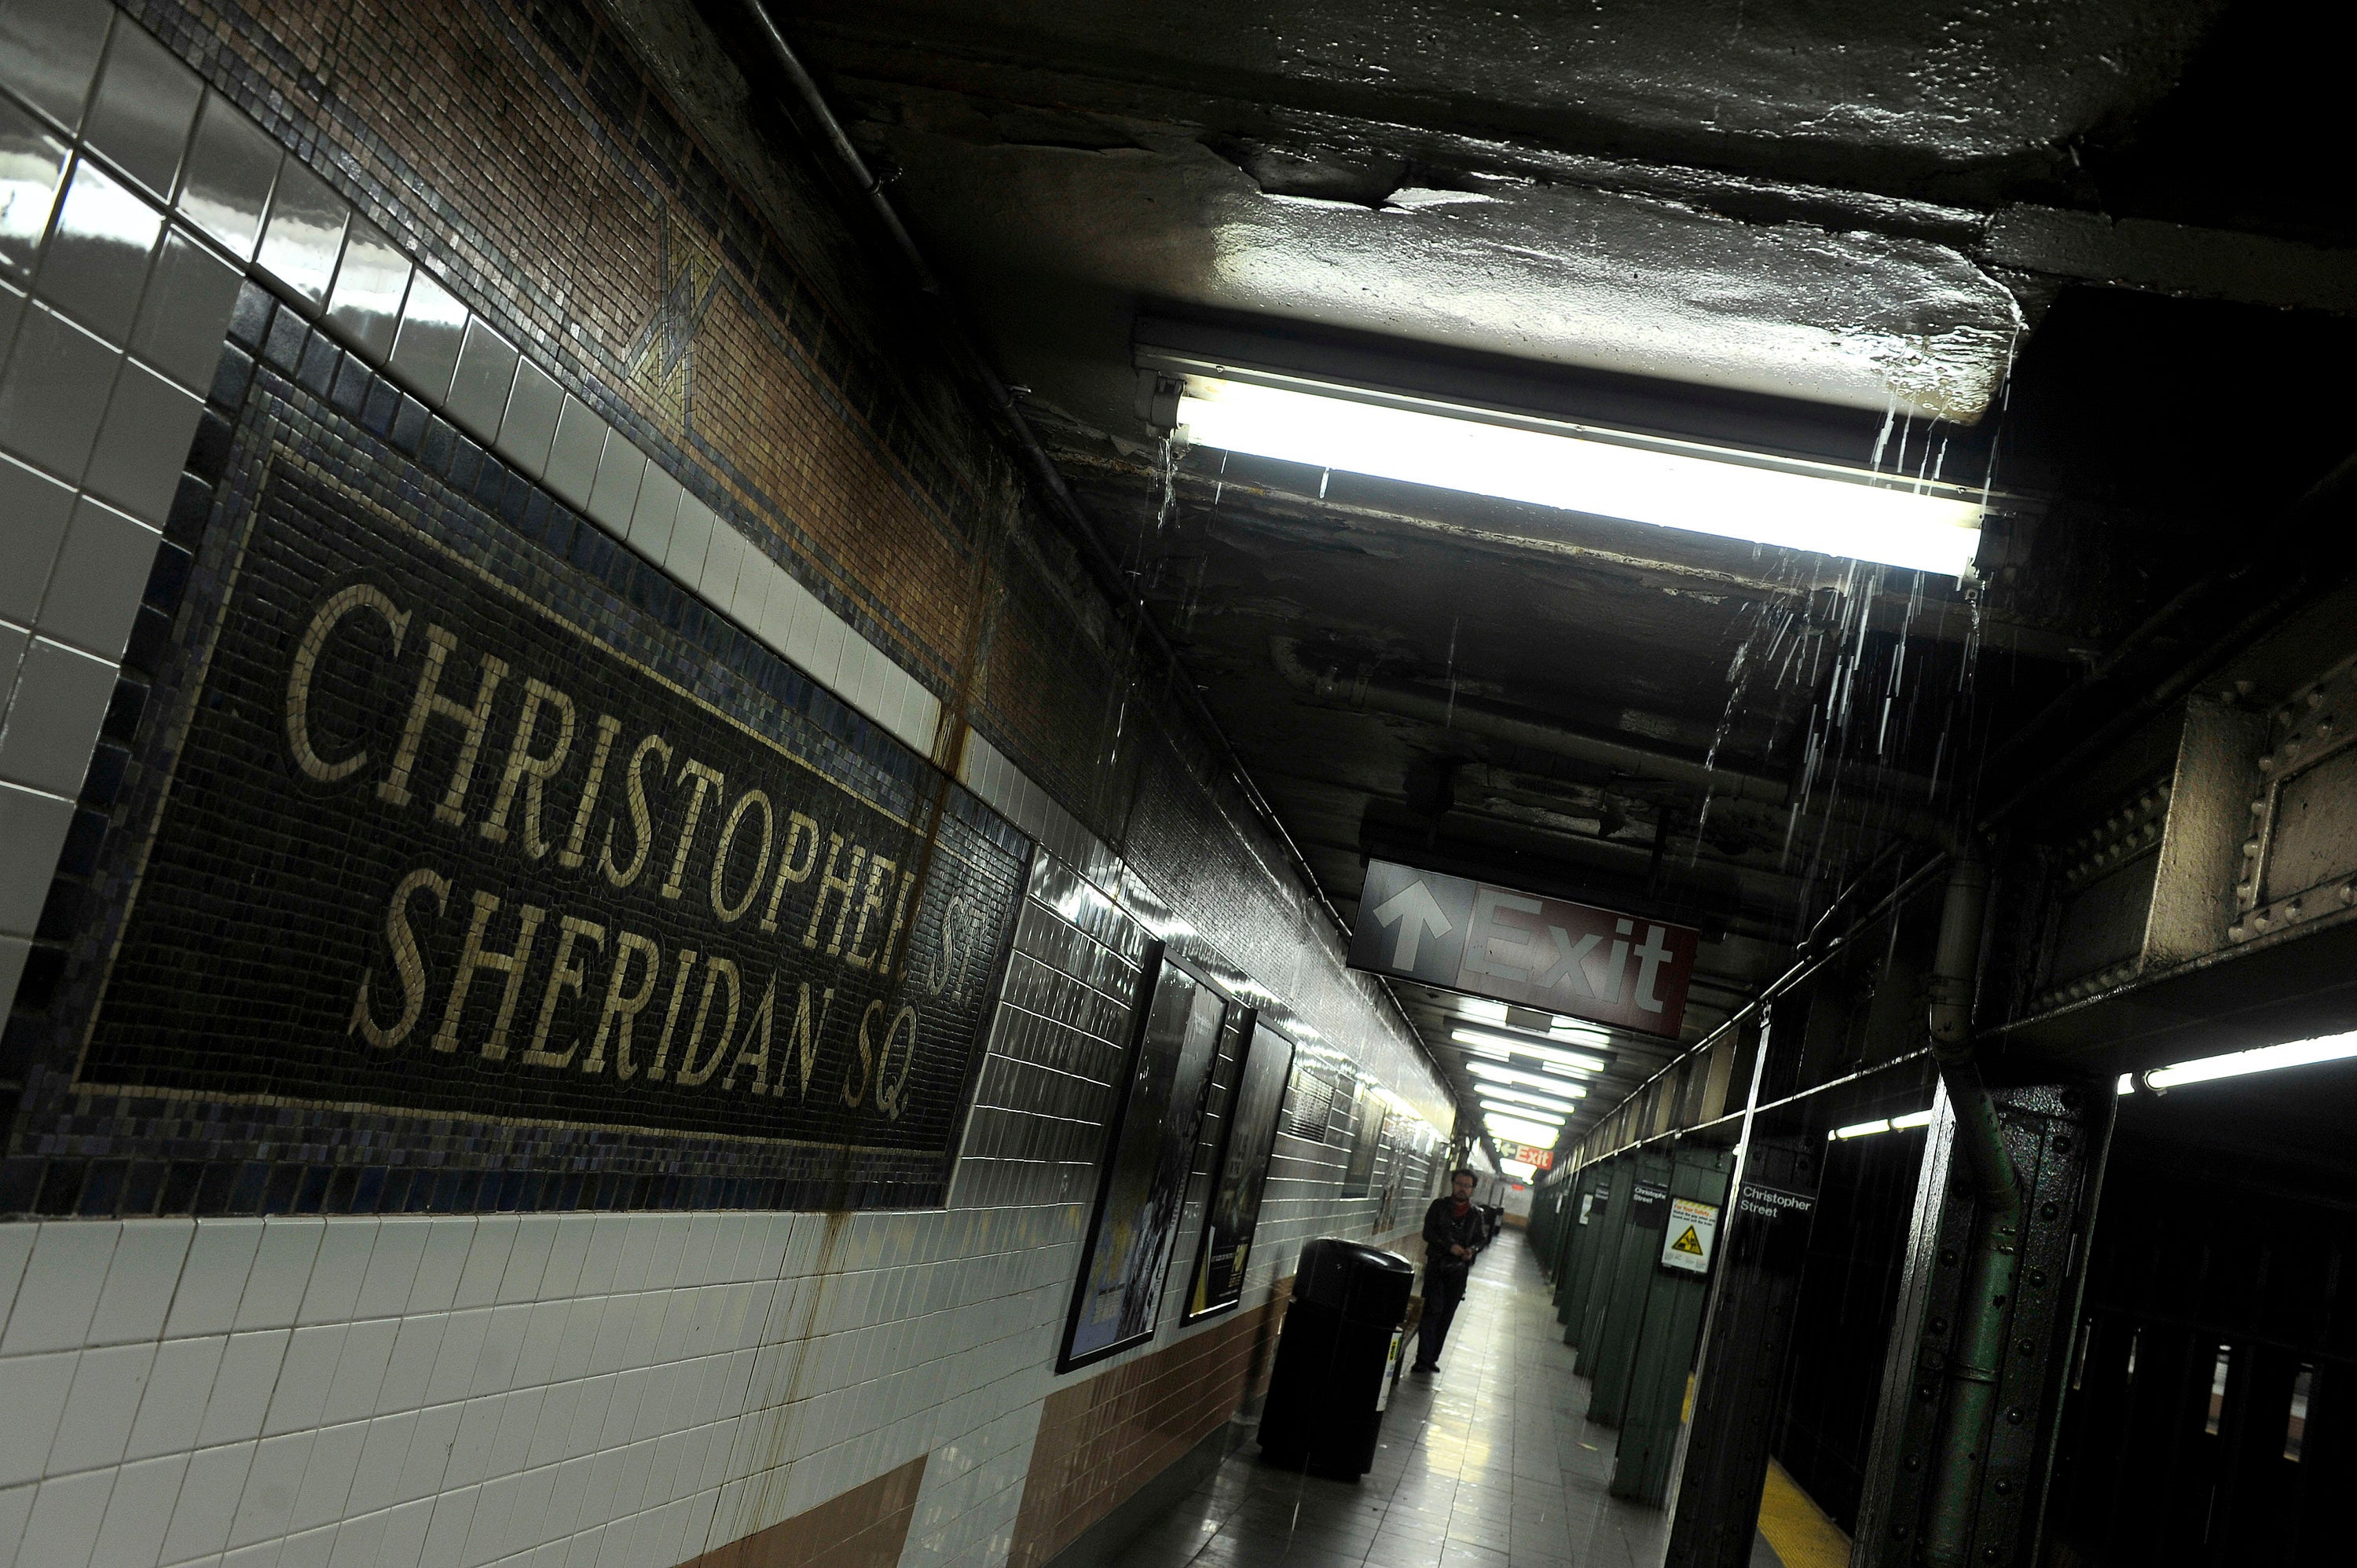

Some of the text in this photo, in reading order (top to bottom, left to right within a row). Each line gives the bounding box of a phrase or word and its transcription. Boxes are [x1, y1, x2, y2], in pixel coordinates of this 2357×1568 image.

[1464, 888, 1674, 1013] Exit
[346, 866, 835, 1105] SHERIDAN
[1516, 1145, 1549, 1167] Exit
[1740, 1200, 1778, 1218] Street
[1743, 1186, 1812, 1211] Christopher
